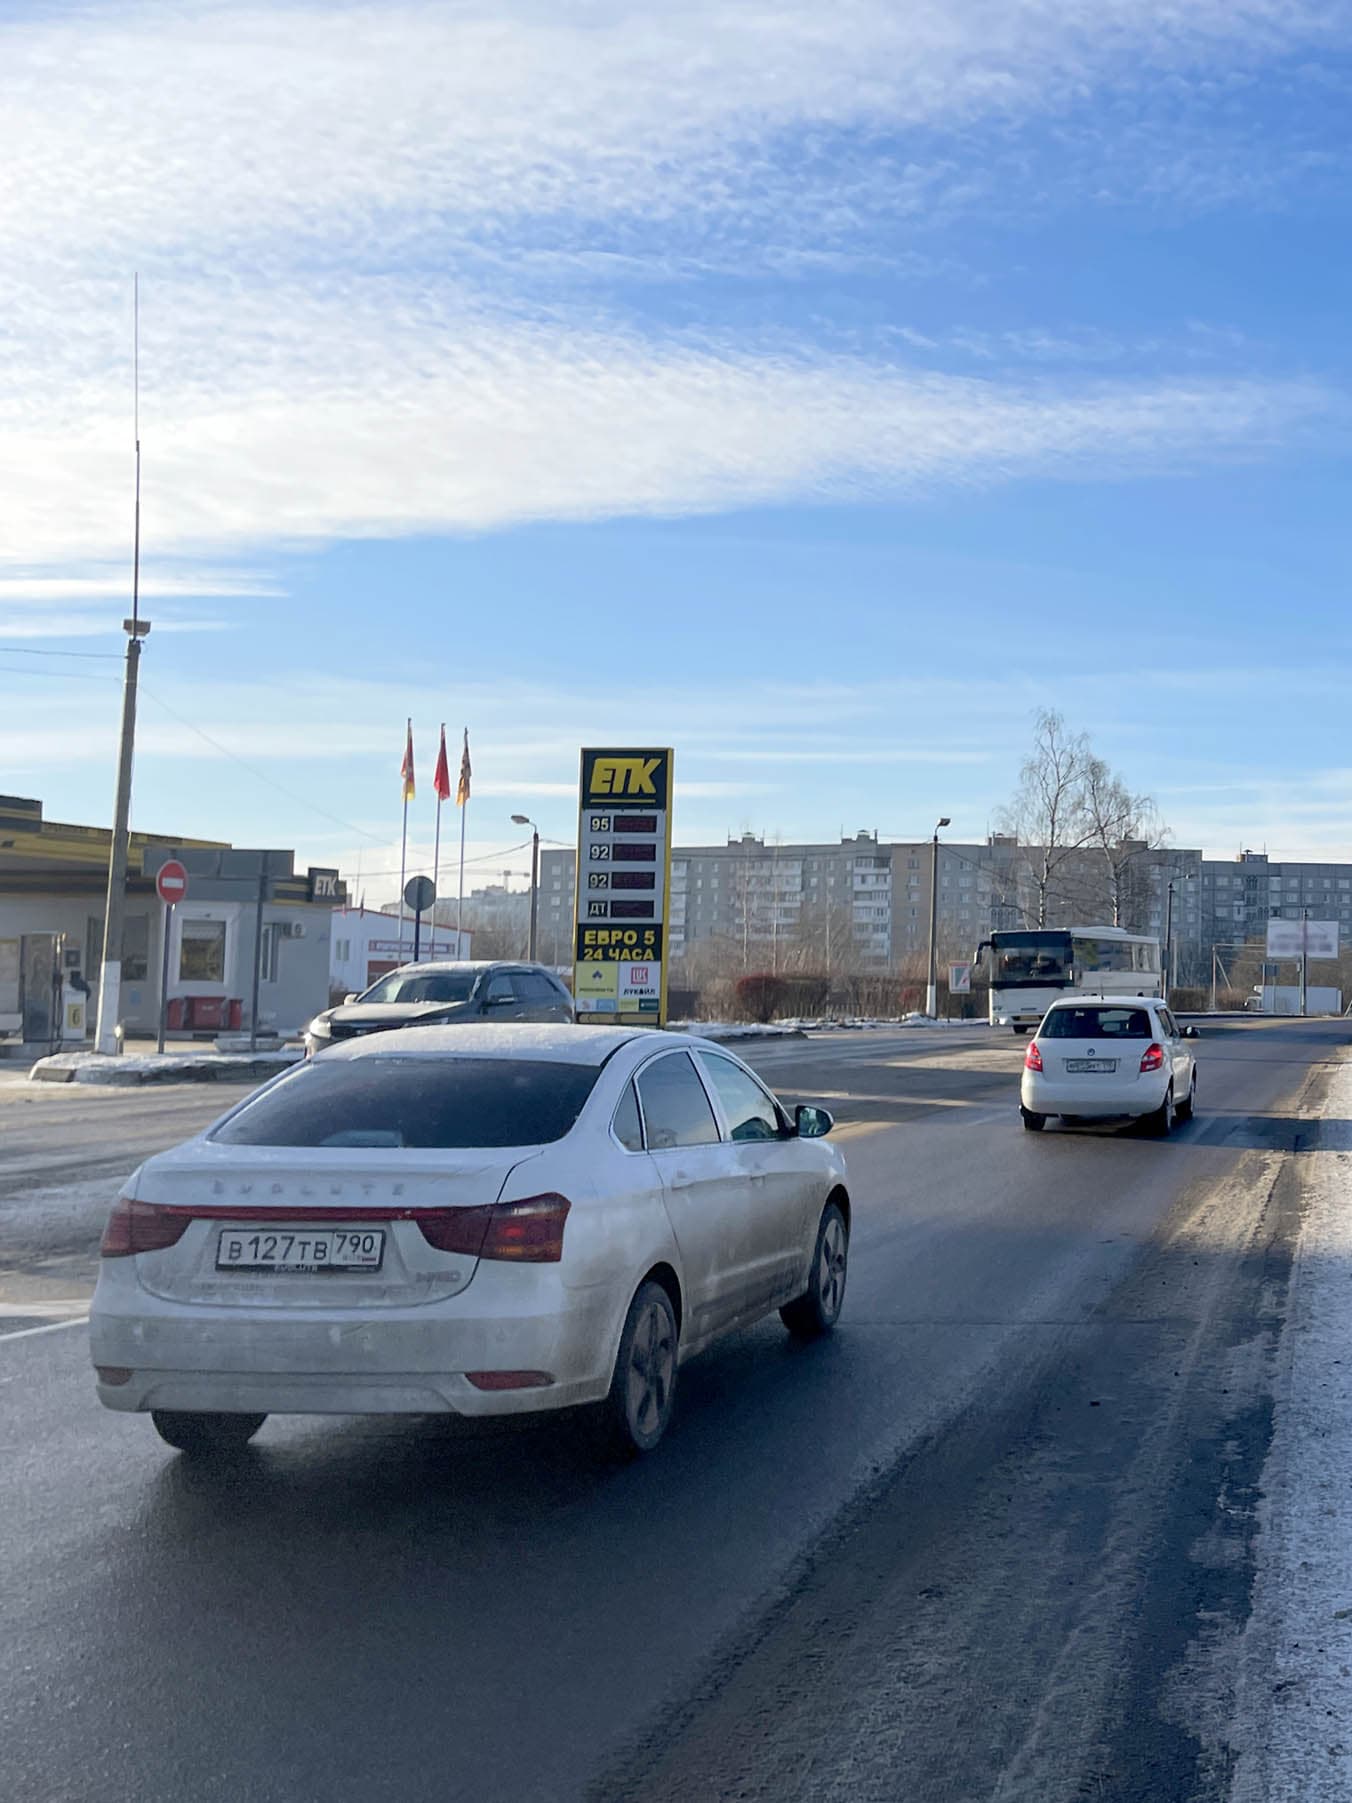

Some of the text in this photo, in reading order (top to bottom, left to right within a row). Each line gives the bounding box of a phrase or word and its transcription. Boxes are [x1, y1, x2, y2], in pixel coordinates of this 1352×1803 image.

[591, 817, 609, 831] 95
[590, 845, 609, 859] 92
[589, 874, 608, 888] 92
[589, 902, 606, 915] ДТ
[584, 929, 655, 945] ЕВРО 5
[583, 948, 655, 960] 24 ЧАСА
[336, 1234, 375, 1254] 790
